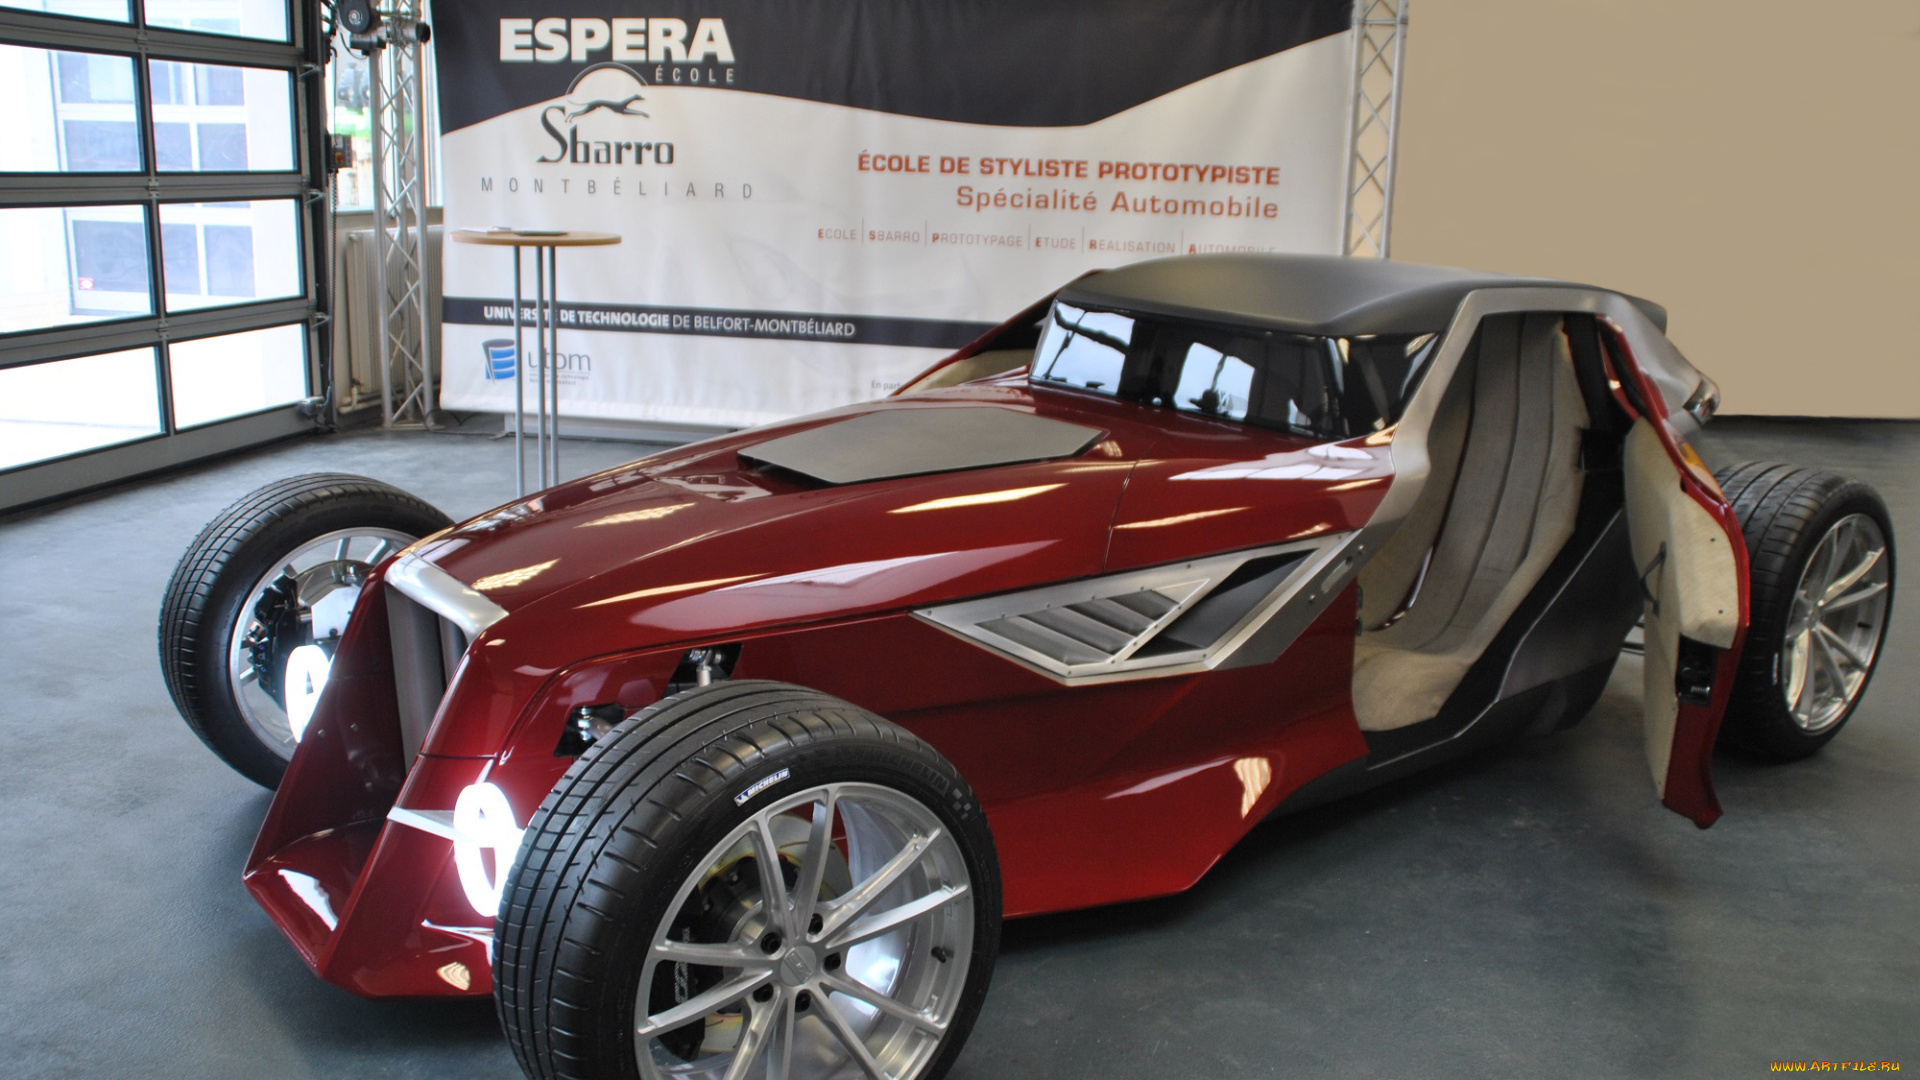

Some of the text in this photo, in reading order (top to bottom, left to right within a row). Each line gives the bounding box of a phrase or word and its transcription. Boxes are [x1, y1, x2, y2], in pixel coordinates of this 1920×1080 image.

[500, 18, 735, 62] ESPERA
[655, 66, 735, 83] ÉCOLE
[536, 105, 675, 164] Sbarro
[858, 149, 1281, 185] ÉCOLE DE STYLISTE PROTOTYPISTE
[481, 177, 753, 199] MONTBÉLIARD
[956, 185, 1279, 219] Spécialité Automobile
[817, 228, 857, 240] ECOLE
[868, 230, 920, 243] SBARRO
[931, 232, 1023, 247] PROTOTYPAGE
[1035, 236, 1077, 250] ETUDE
[1089, 239, 1176, 254] REALISATION
[483, 305, 856, 337] UNIVRST DE TECHNOLOGIE DE BELFORT-MONTBÉLIARD
